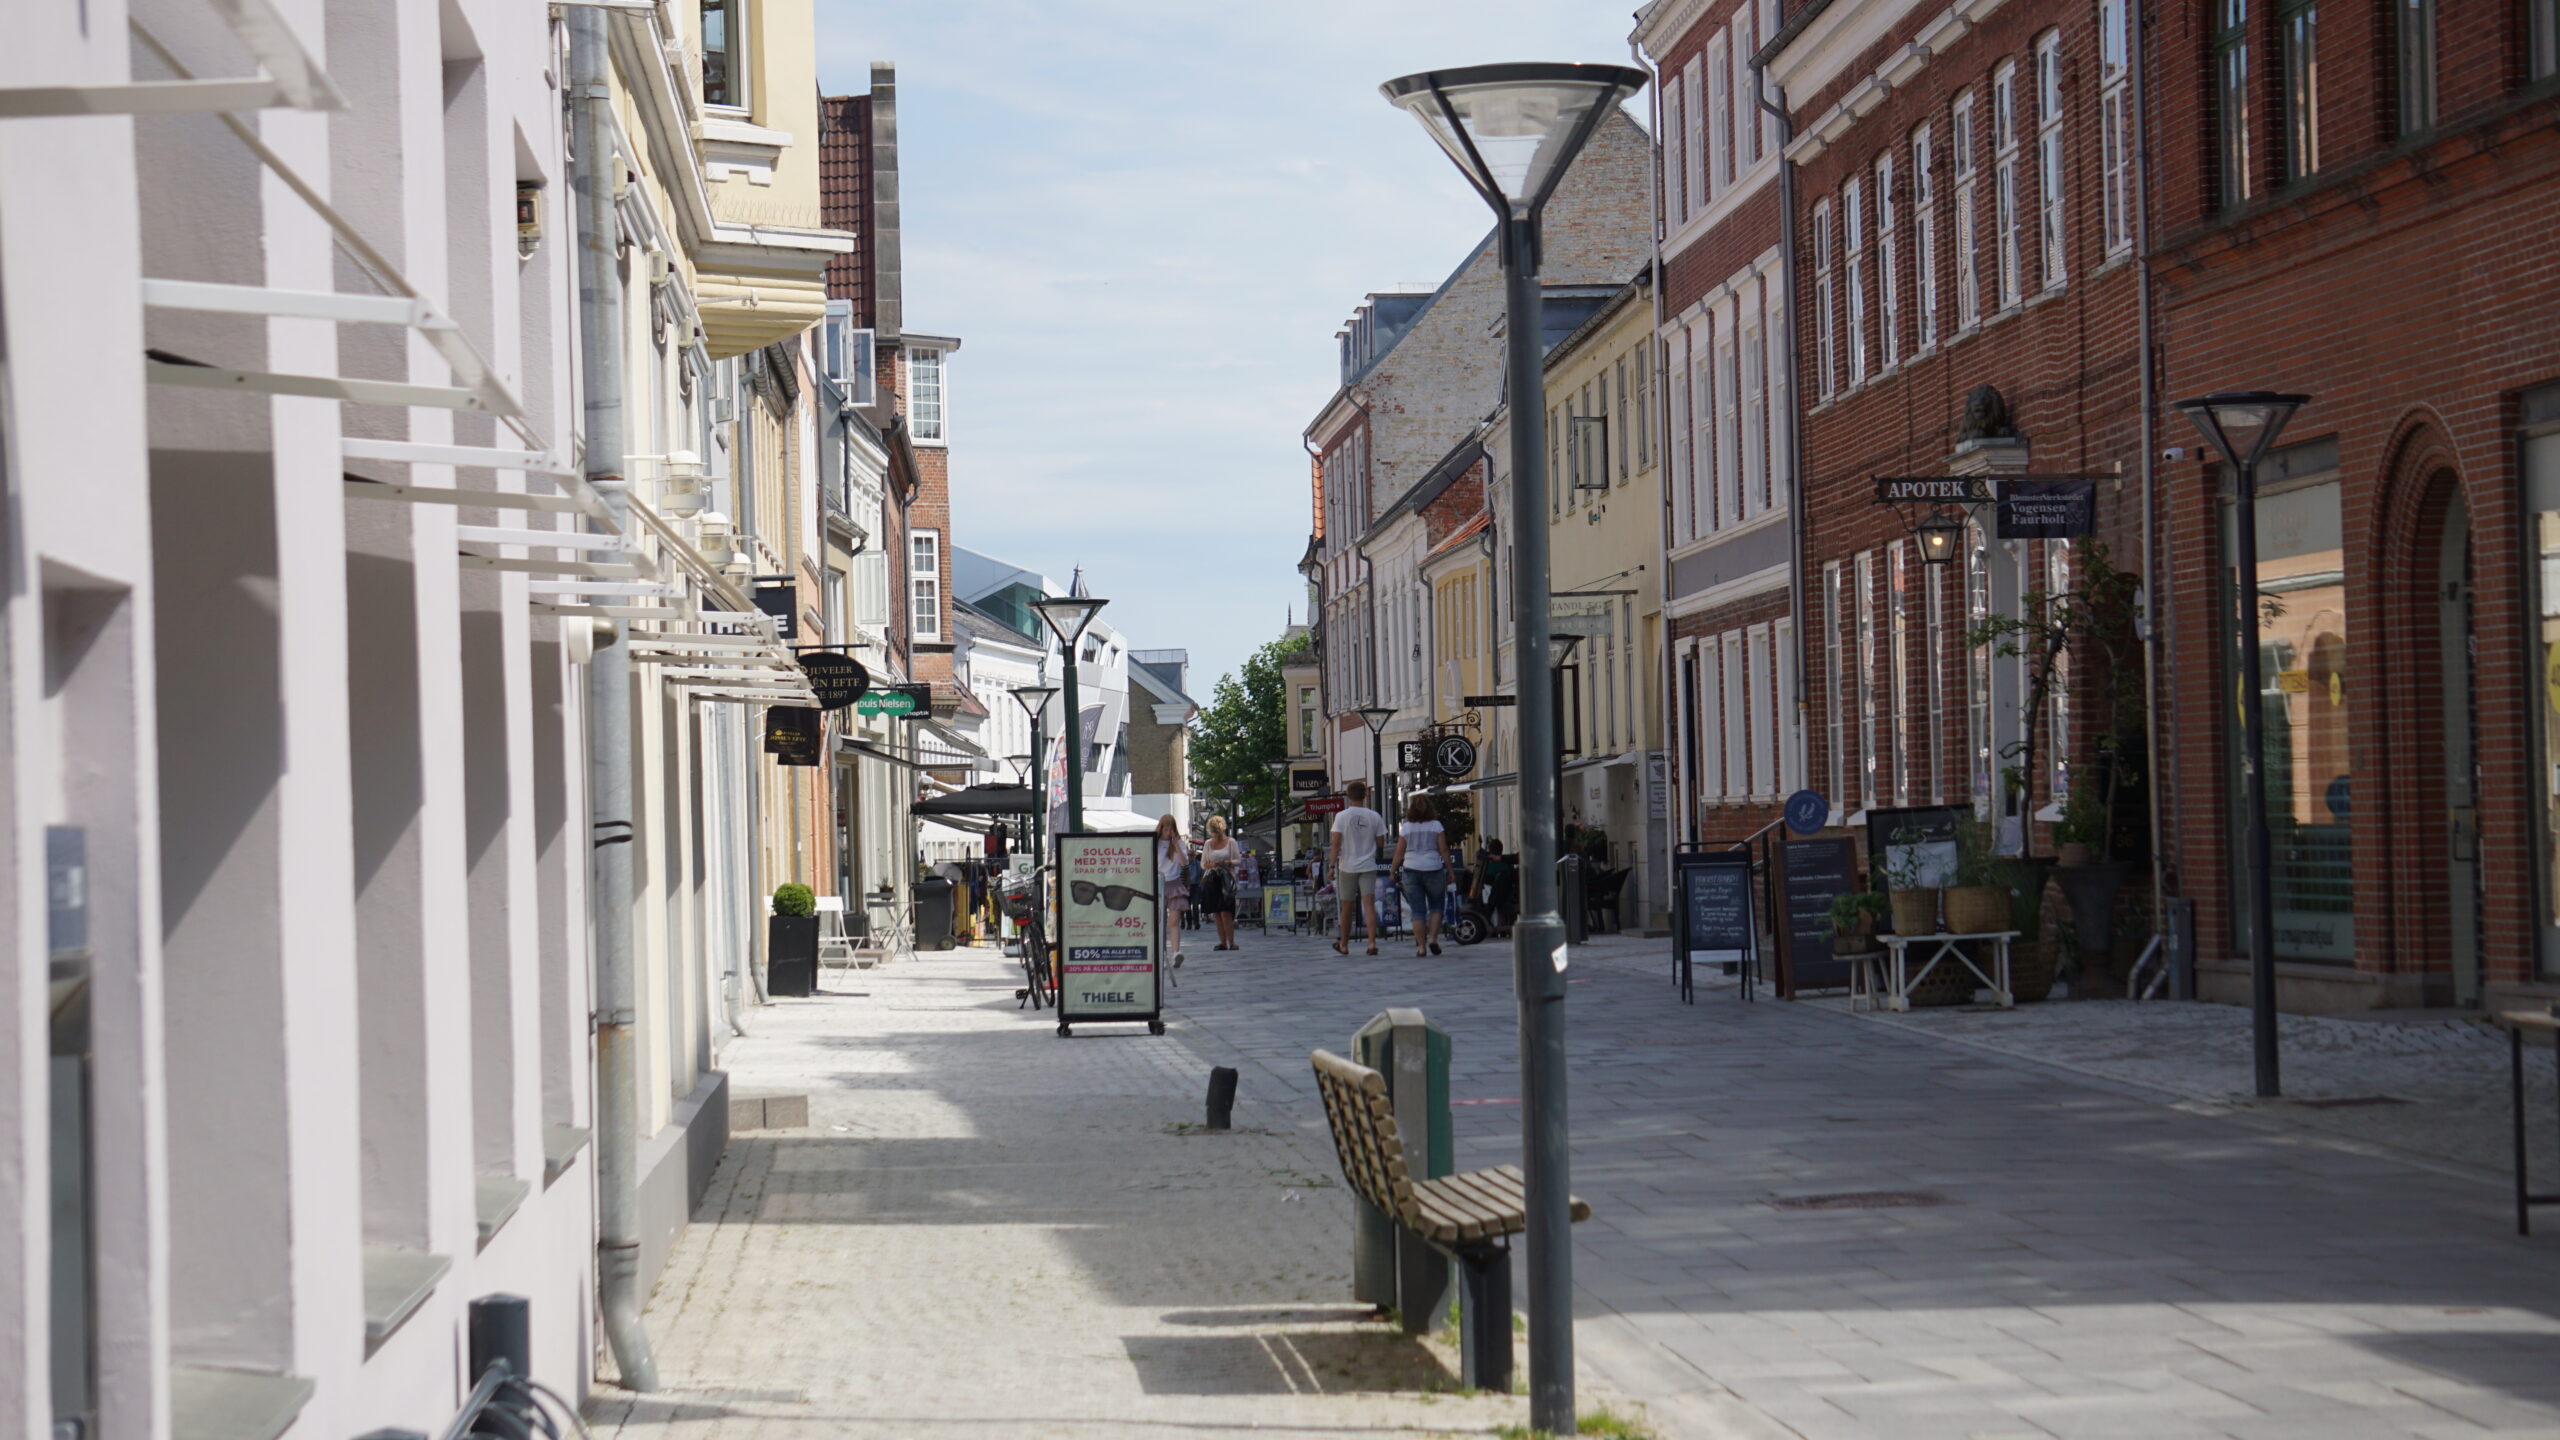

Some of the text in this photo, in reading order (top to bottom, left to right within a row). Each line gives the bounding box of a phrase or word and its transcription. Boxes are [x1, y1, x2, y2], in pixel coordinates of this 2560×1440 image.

[1888, 481, 1965, 498] APOTEK
[2010, 503, 2066, 515] Vogensen
[2011, 514, 2065, 525] Faurholt
[810, 666, 852, 677] JUVELER
[828, 690, 848, 699] 1897
[878, 698, 911, 708] Nielsen
[1083, 848, 1132, 856] SOLGLAS
[1074, 857, 1141, 866] MED STYRKE
[1074, 949, 1101, 959] 50%
[1082, 992, 1134, 1003] THIELE
